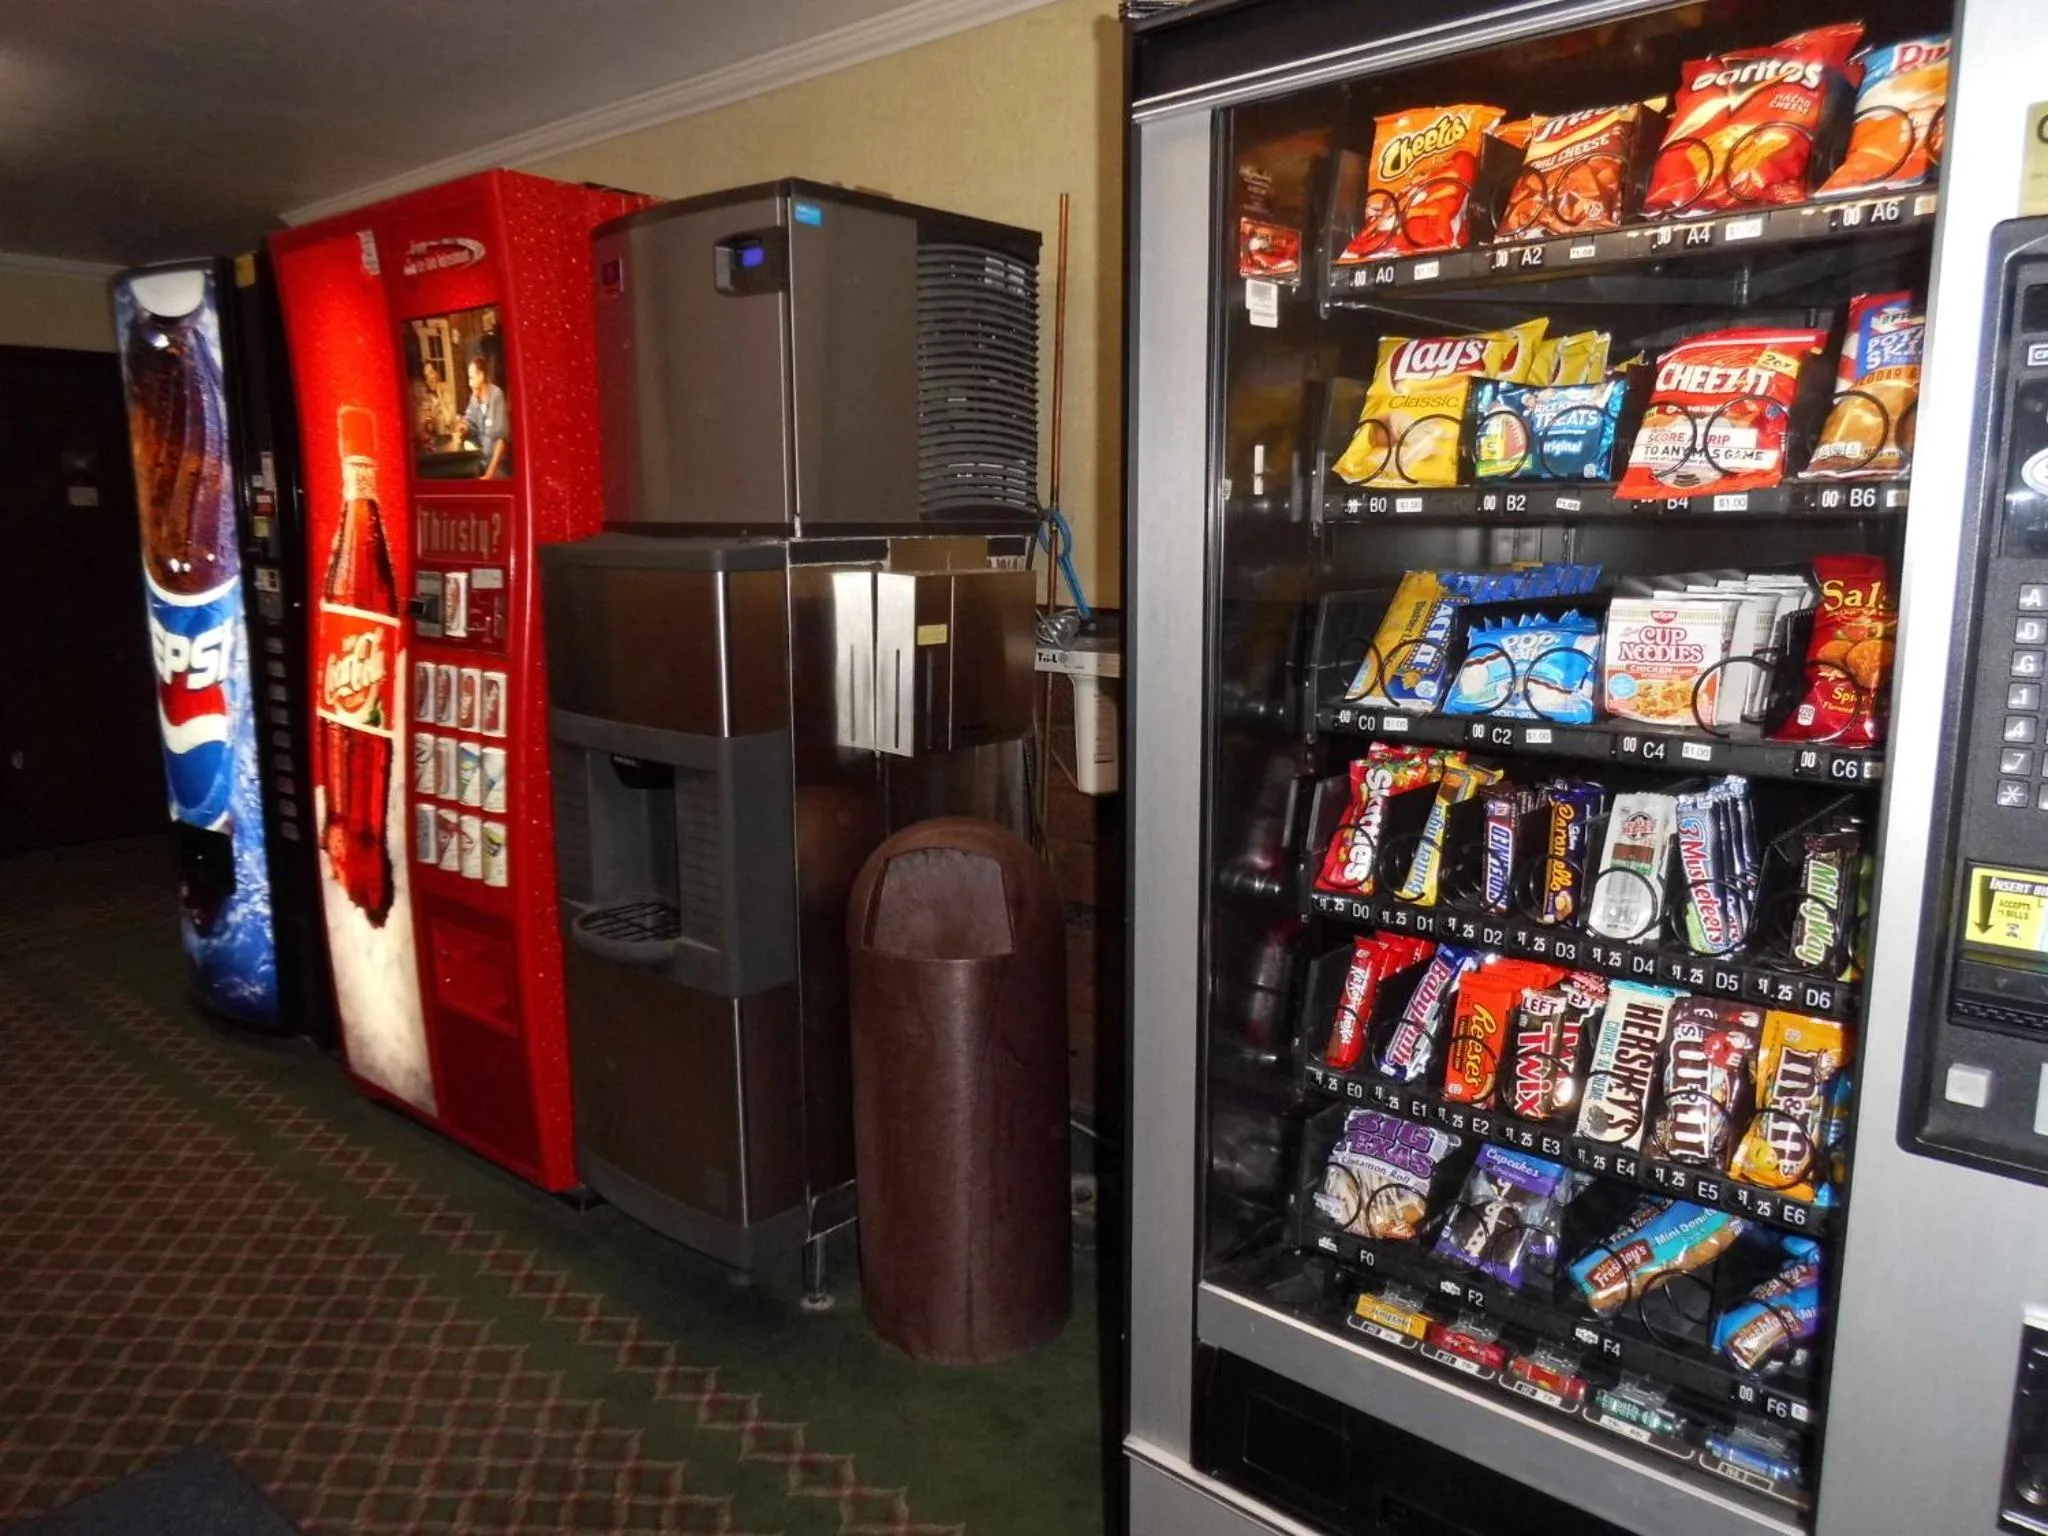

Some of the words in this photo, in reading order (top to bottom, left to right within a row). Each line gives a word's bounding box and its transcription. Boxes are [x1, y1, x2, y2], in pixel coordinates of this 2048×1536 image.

[1870, 201, 1900, 222] A6
[1686, 226, 1710, 245] A4
[1521, 247, 1542, 265] A2
[1375, 265, 1394, 284] A0
[1387, 394, 1460, 409] Classic
[1647, 431, 1686, 444] SCORE
[1543, 439, 1582, 457] riginal
[1644, 445, 1660, 456] TO
[1661, 446, 1689, 458] ANY
[1691, 449, 1720, 460] MS
[1723, 449, 1764, 461] GAME
[1369, 497, 1387, 513] B0
[1506, 495, 1526, 511] B2
[1849, 488, 1876, 507] B6
[420, 511, 501, 561] Thirsty?
[2029, 587, 2042, 608] A
[1638, 625, 1688, 646] CUP
[2023, 621, 2039, 640] D
[1617, 641, 1705, 663] NOODLES
[2020, 655, 2035, 674] G
[2018, 687, 2028, 706] 1
[1358, 715, 1376, 731] C0
[1491, 727, 1512, 744] C2
[1643, 741, 1665, 759] C4
[1831, 759, 1858, 778] C6
[2013, 752, 2026, 768] 7
[1679, 826, 1699, 840] 3
[1679, 838, 1724, 945] Musketeers
[1989, 876, 2029, 894] INSERT
[1352, 903, 1370, 919] D0
[1999, 899, 2031, 911] ACCEPTS
[1416, 915, 1434, 932] D1
[1483, 928, 1503, 946] D2
[1794, 915, 1836, 965] Way
[1555, 942, 1576, 960] D3
[1632, 956, 1655, 975] D4
[1715, 972, 1739, 991] D5
[1523, 996, 1558, 1015] LEFT
[1805, 989, 1832, 1008] D6
[1598, 1020, 1619, 1056] COOKIES
[1605, 1003, 1664, 1136] HERSHEY'S
[1346, 1083, 1362, 1098] E0
[1412, 1101, 1427, 1117] E1
[1472, 1117, 1489, 1136] E2
[1542, 1137, 1561, 1155] E3
[1486, 1147, 1540, 1178] Cupcakes
[1616, 1158, 1636, 1177] E4
[1389, 1170, 1411, 1184] Roll
[1697, 1181, 1719, 1201] E5
[1783, 1204, 1806, 1225] E6
[1654, 1227, 1681, 1246] Mini
[1360, 1249, 1375, 1267] F0
[1594, 1245, 1649, 1288] Fresley's
[1468, 1288, 1484, 1307] F2
[1603, 1338, 1621, 1358] F4
[1767, 1397, 1787, 1418] F6
